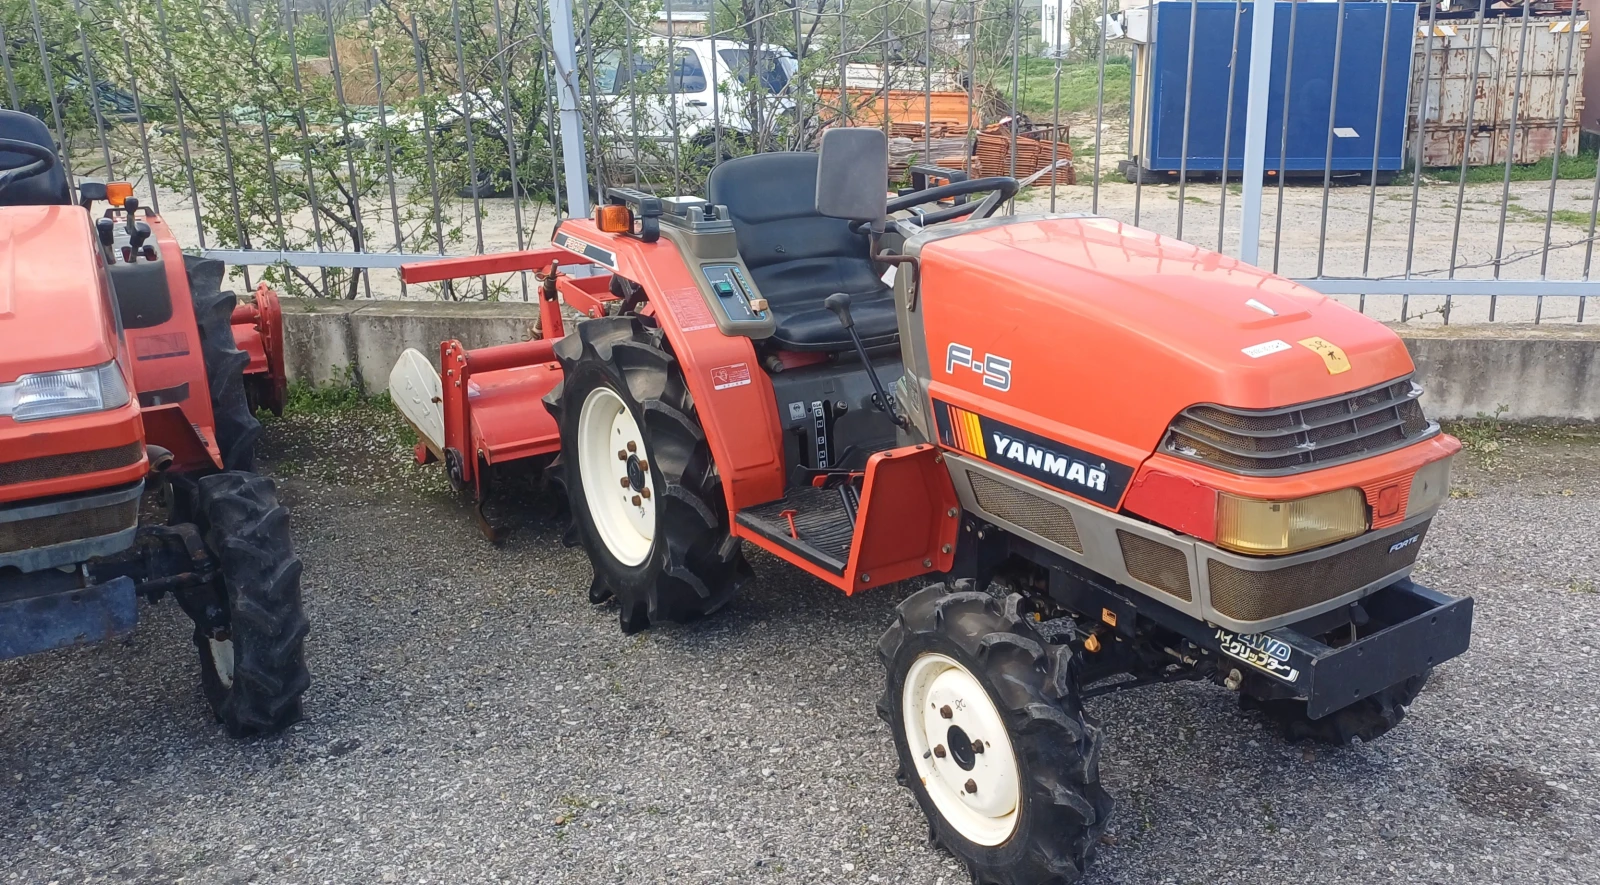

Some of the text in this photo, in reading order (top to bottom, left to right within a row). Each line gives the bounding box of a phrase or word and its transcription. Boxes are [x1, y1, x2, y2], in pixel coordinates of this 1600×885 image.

[946, 342, 1012, 392] F-5
[992, 433, 1108, 492] YANMAR
[1389, 534, 1420, 553] FORTE
[1214, 629, 1291, 671] ハイグリップター
[1238, 633, 1292, 662] 4WD
